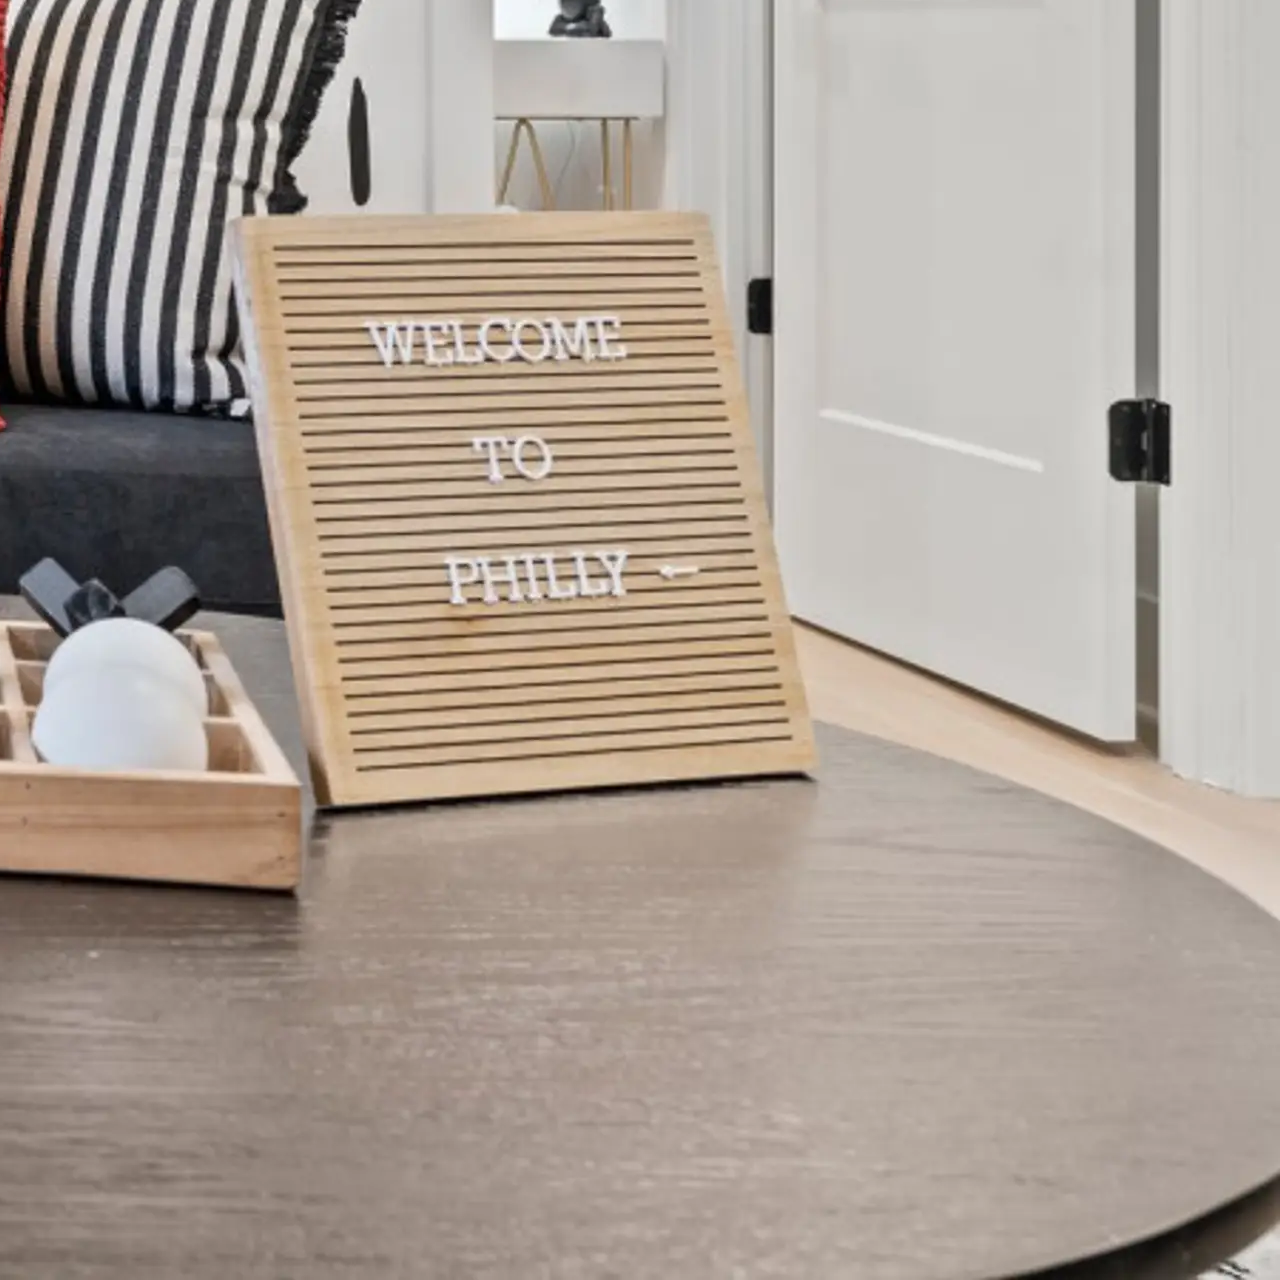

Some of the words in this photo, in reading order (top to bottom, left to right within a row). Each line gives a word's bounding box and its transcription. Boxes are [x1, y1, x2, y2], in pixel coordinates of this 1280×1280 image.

[364, 315, 628, 369] WELCOME
[471, 434, 553, 484] TO
[444, 548, 628, 605] PHILLY
